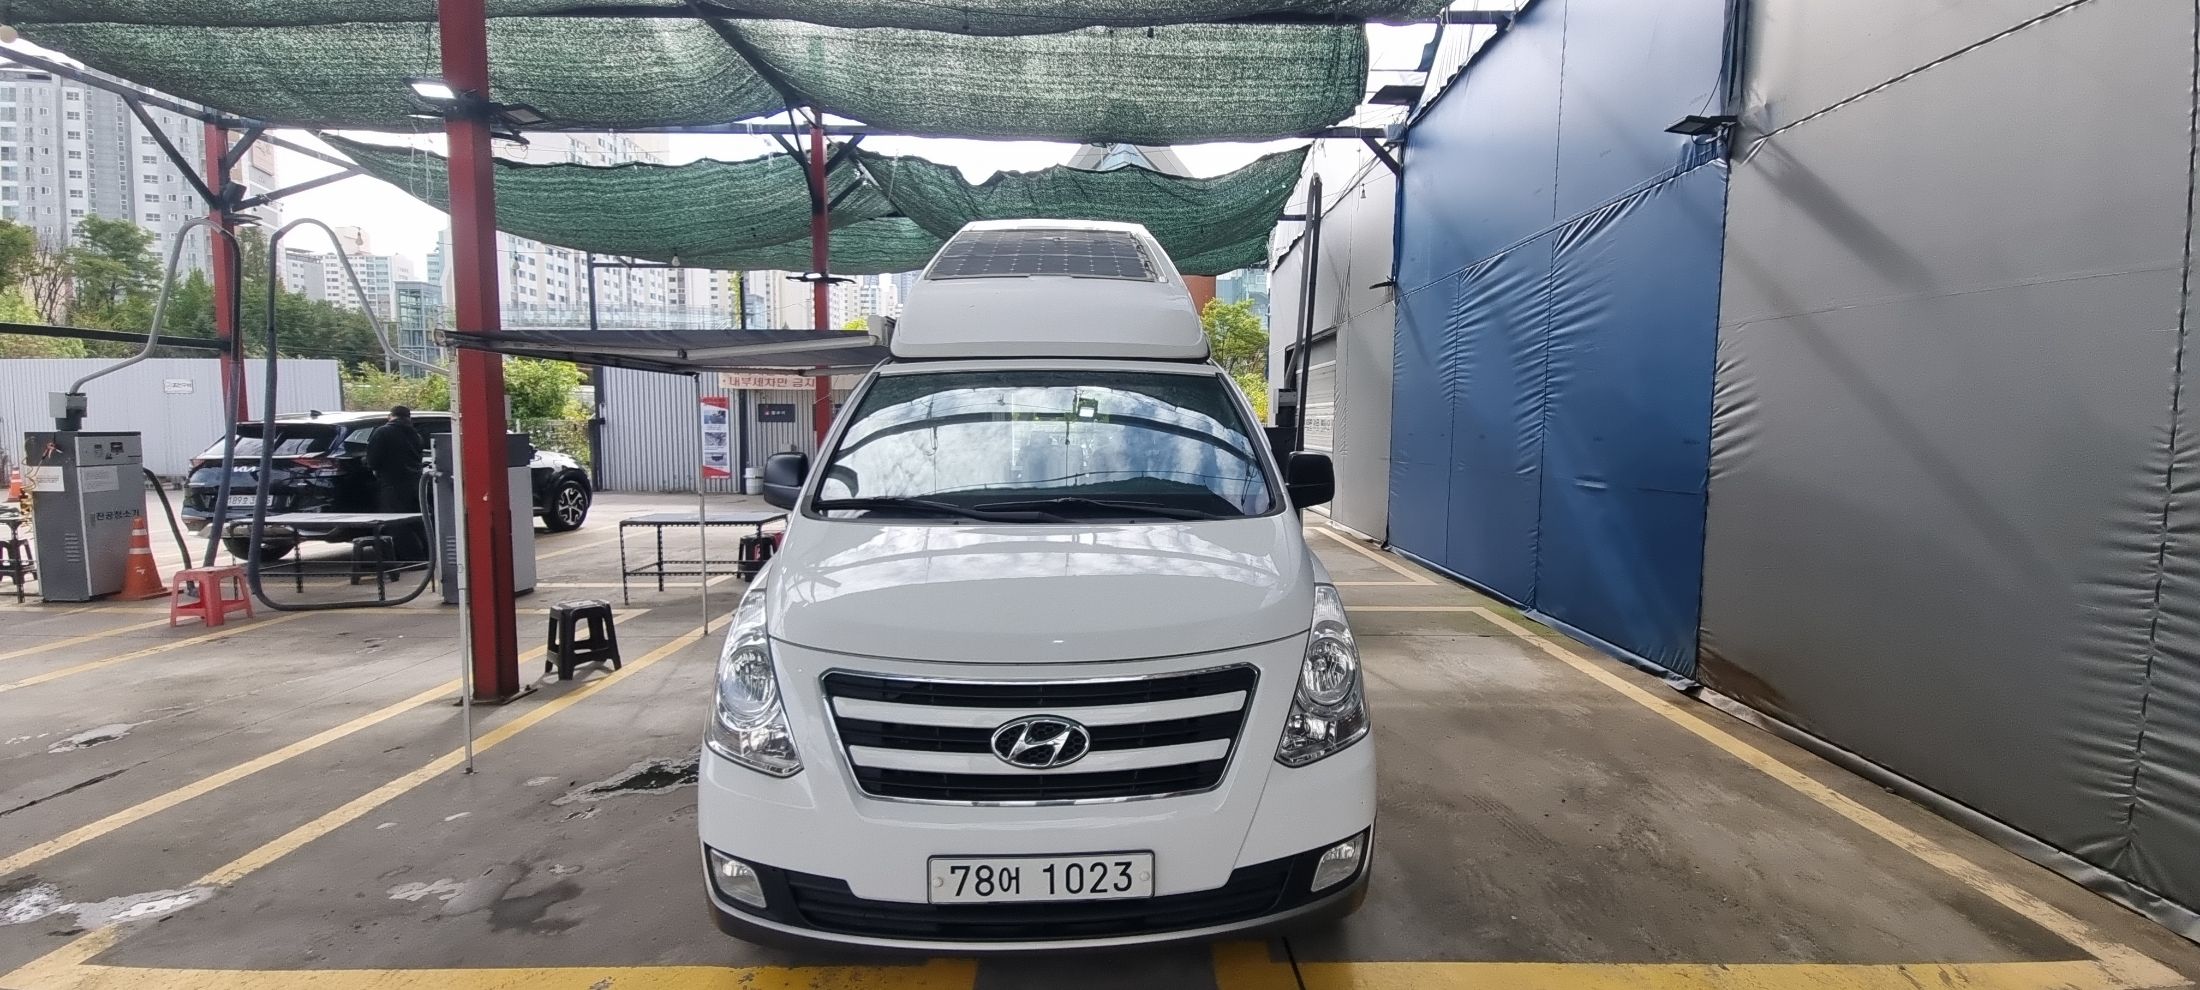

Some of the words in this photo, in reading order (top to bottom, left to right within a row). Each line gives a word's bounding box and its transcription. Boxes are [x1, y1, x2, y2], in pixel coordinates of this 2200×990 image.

[729, 376, 788, 388] 내부세차만
[792, 377, 815, 388] 금지
[96, 508, 140, 521] 진공청소기
[950, 865, 1020, 897] 78어
[1042, 861, 1133, 896] 1023
